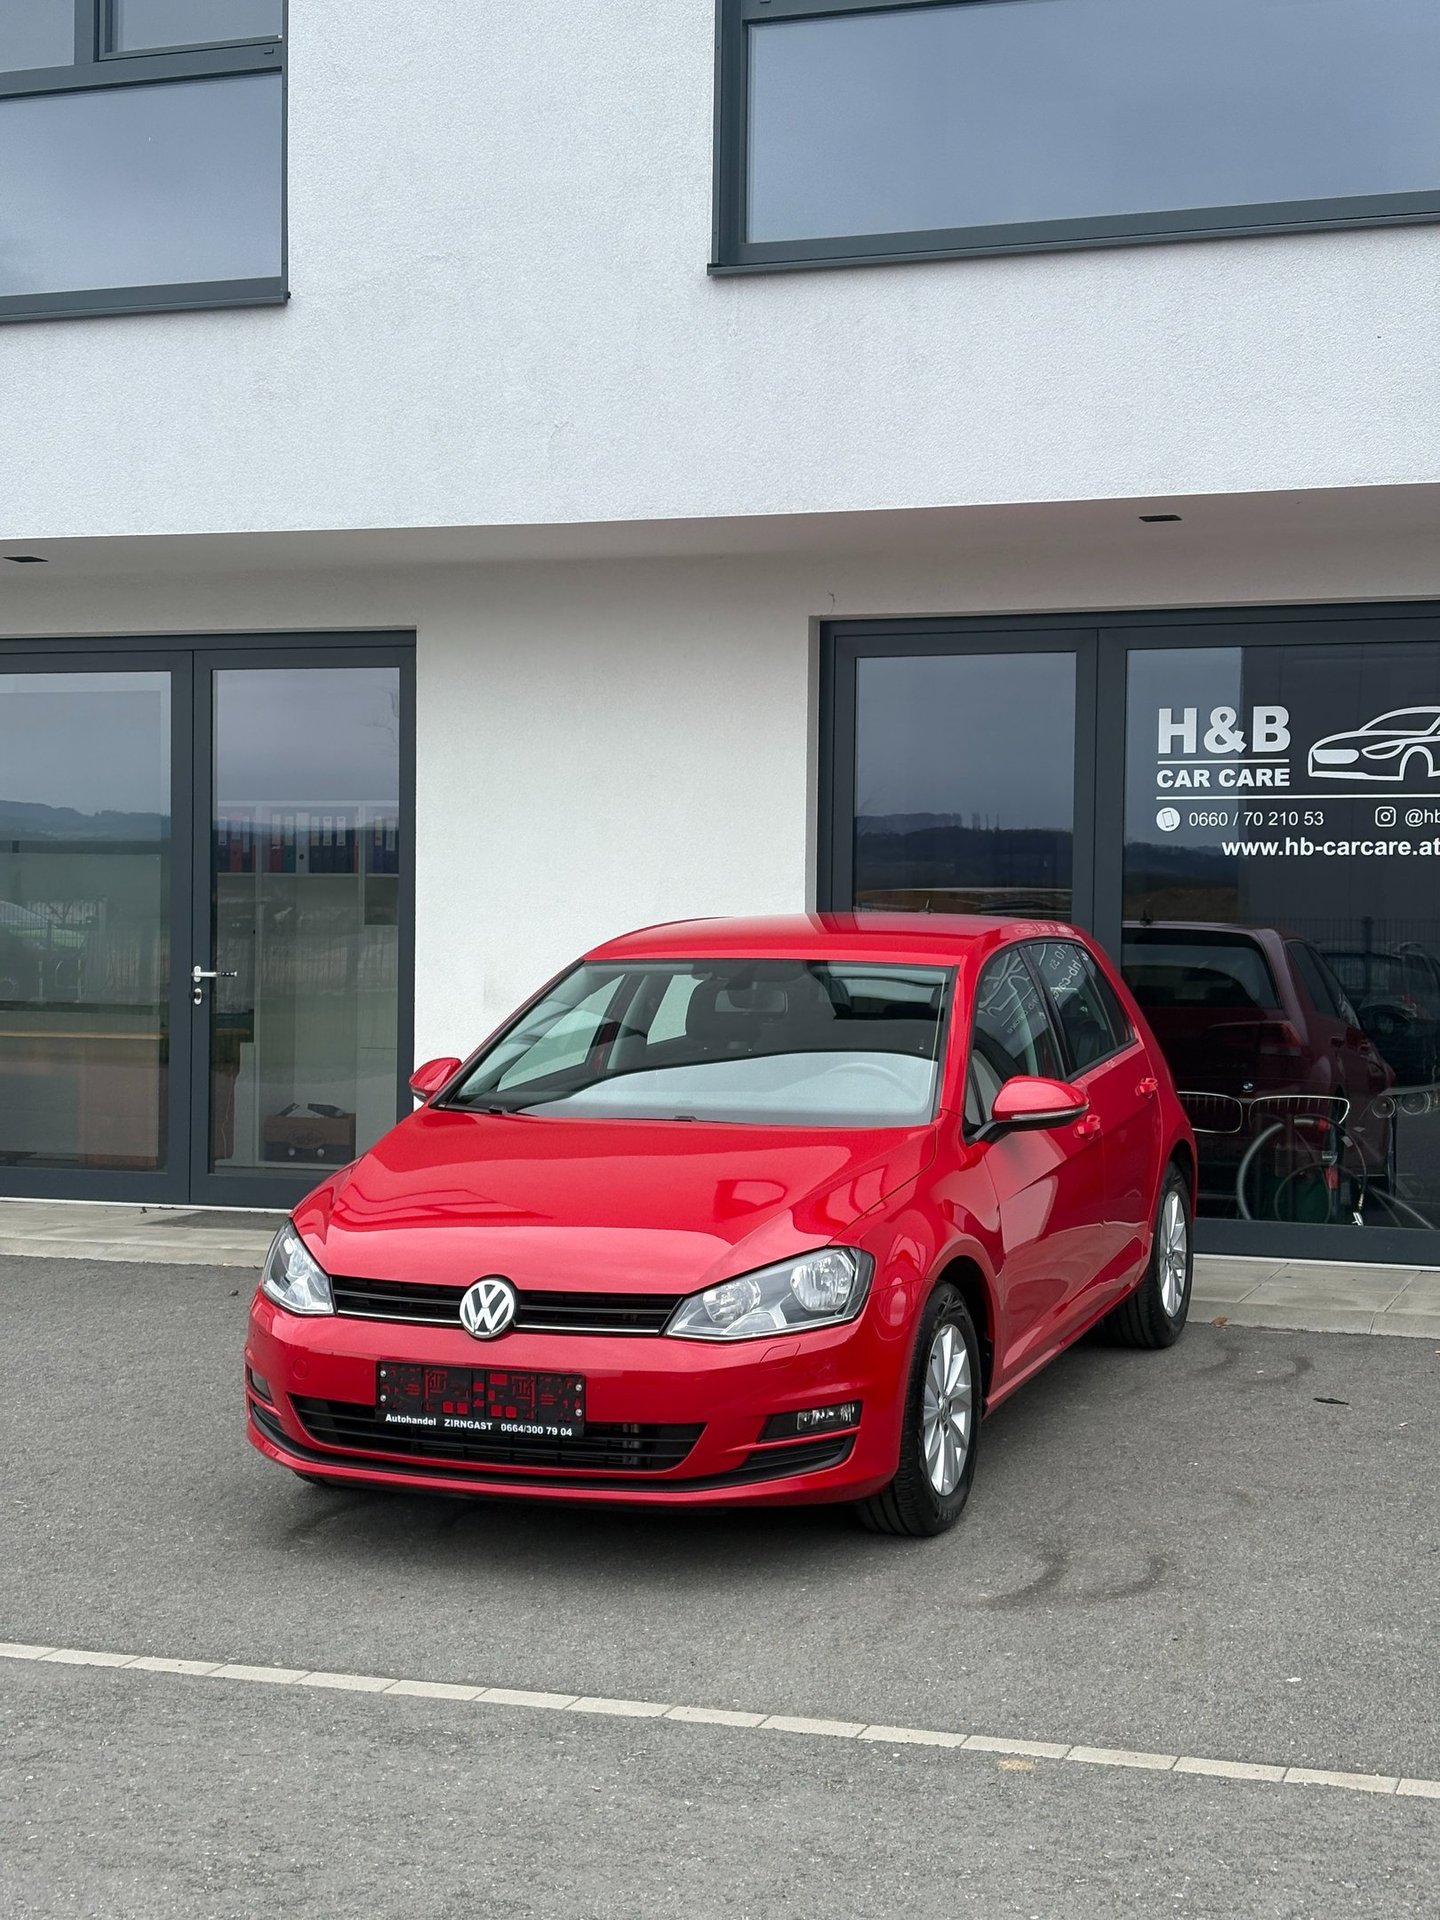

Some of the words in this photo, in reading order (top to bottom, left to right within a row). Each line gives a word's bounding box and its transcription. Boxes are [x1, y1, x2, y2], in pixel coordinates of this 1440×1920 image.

[1157, 705, 1291, 754] H&B
[1156, 769, 1211, 788] CAR
[1218, 768, 1291, 788] CARE
[1188, 811, 1229, 827] 0660
[1243, 811, 1264, 826] 70
[1268, 811, 1299, 826] 210
[1303, 811, 1324, 826] 53
[1221, 836, 1440, 856] www.hb-carcare.at
[459, 1279, 515, 1337] VW
[385, 1413, 437, 1426] Autohandel
[444, 1418, 493, 1430] ZIRNGAST
[500, 1423, 544, 1435] 0664/300
[546, 1426, 558, 1436] 79
[560, 1427, 573, 1437] 04
